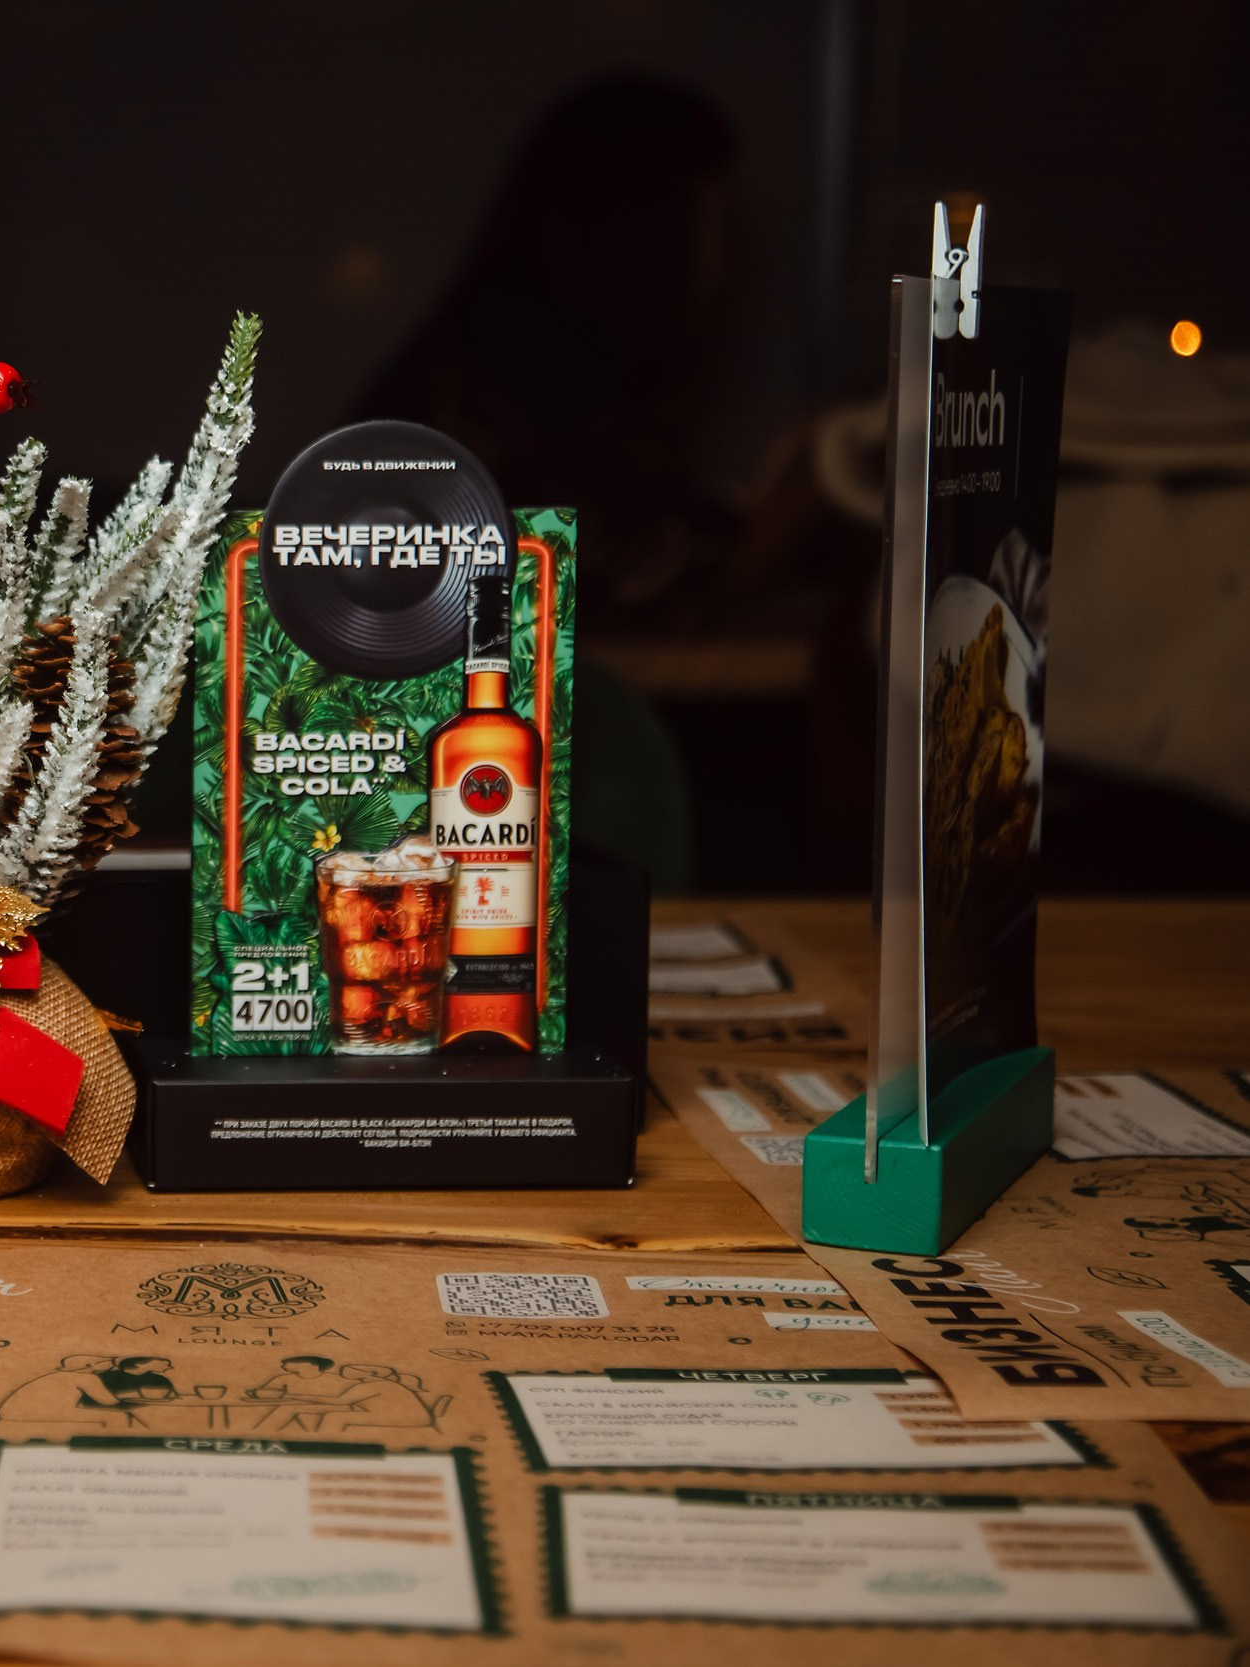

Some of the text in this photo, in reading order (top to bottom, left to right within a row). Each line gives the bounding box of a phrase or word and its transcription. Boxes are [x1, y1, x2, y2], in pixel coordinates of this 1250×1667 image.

[935, 369, 1006, 448] Brunch
[323, 460, 456, 471] БУДЬ В ДВИЖЕНИИ
[273, 524, 505, 546] ВЕЧЕРИНКА
[272, 546, 506, 568] ТАМ, ГДЕ ТЫ
[255, 729, 405, 751] BACARDÍ
[253, 755, 407, 774] SPICED &
[435, 817, 537, 846] BACARDÍ
[462, 852, 509, 861] SPICED
[232, 962, 310, 991] 2+1
[236, 999, 310, 1025] 4700
[664, 1295, 864, 1311] ДЛЯ ВА
[110, 1323, 351, 1341] МЯТА
[871, 1257, 1110, 1388] БИЗНЕС
[178, 1338, 282, 1347] LOUNGE
[1074, 1325, 1194, 1388] По будням
[678, 1371, 828, 1382] ЧЕТВЕРГ
[163, 1439, 289, 1454] СРЕДА
